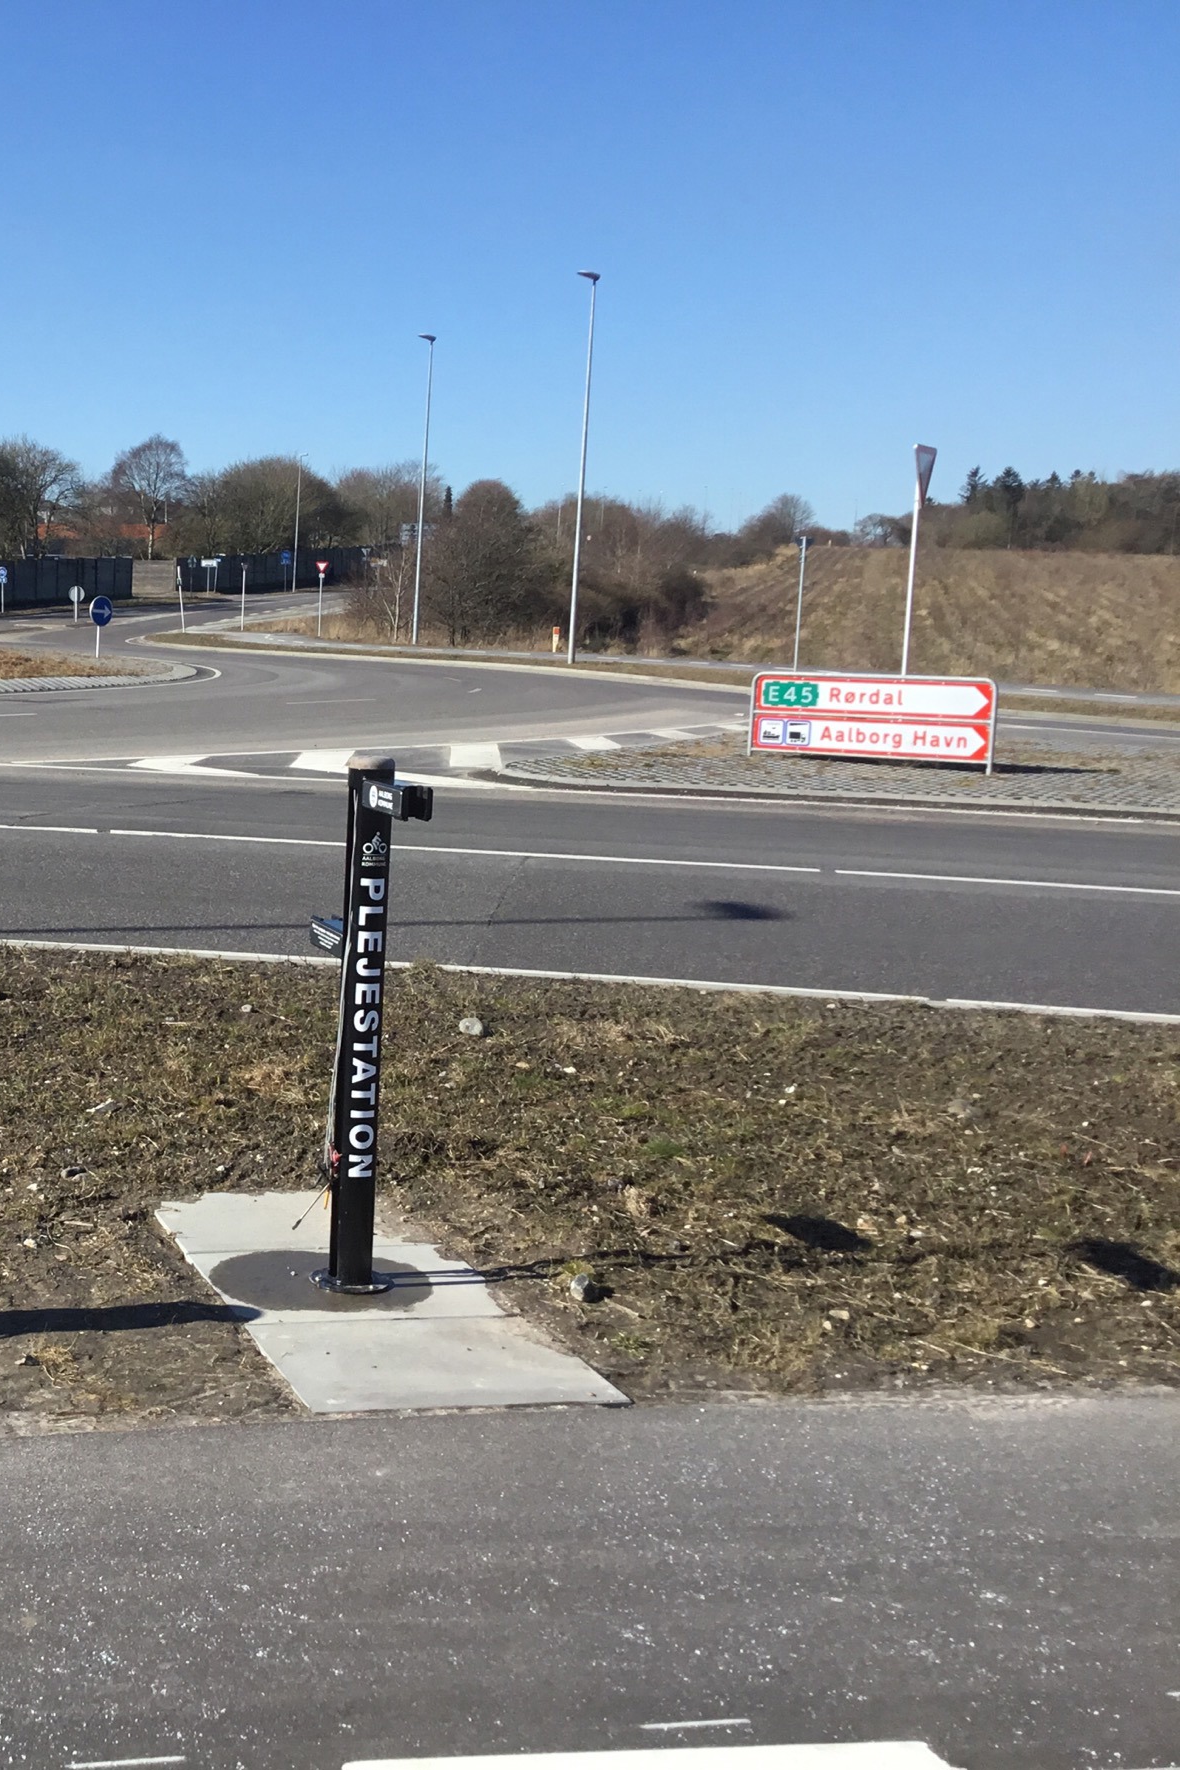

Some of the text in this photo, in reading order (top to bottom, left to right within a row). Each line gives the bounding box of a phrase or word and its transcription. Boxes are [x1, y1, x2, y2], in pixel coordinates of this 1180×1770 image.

[768, 686, 903, 705] E45 Rørdal
[820, 726, 967, 748] Aalborg Havn
[348, 877, 385, 1179] PLEJESTATION
